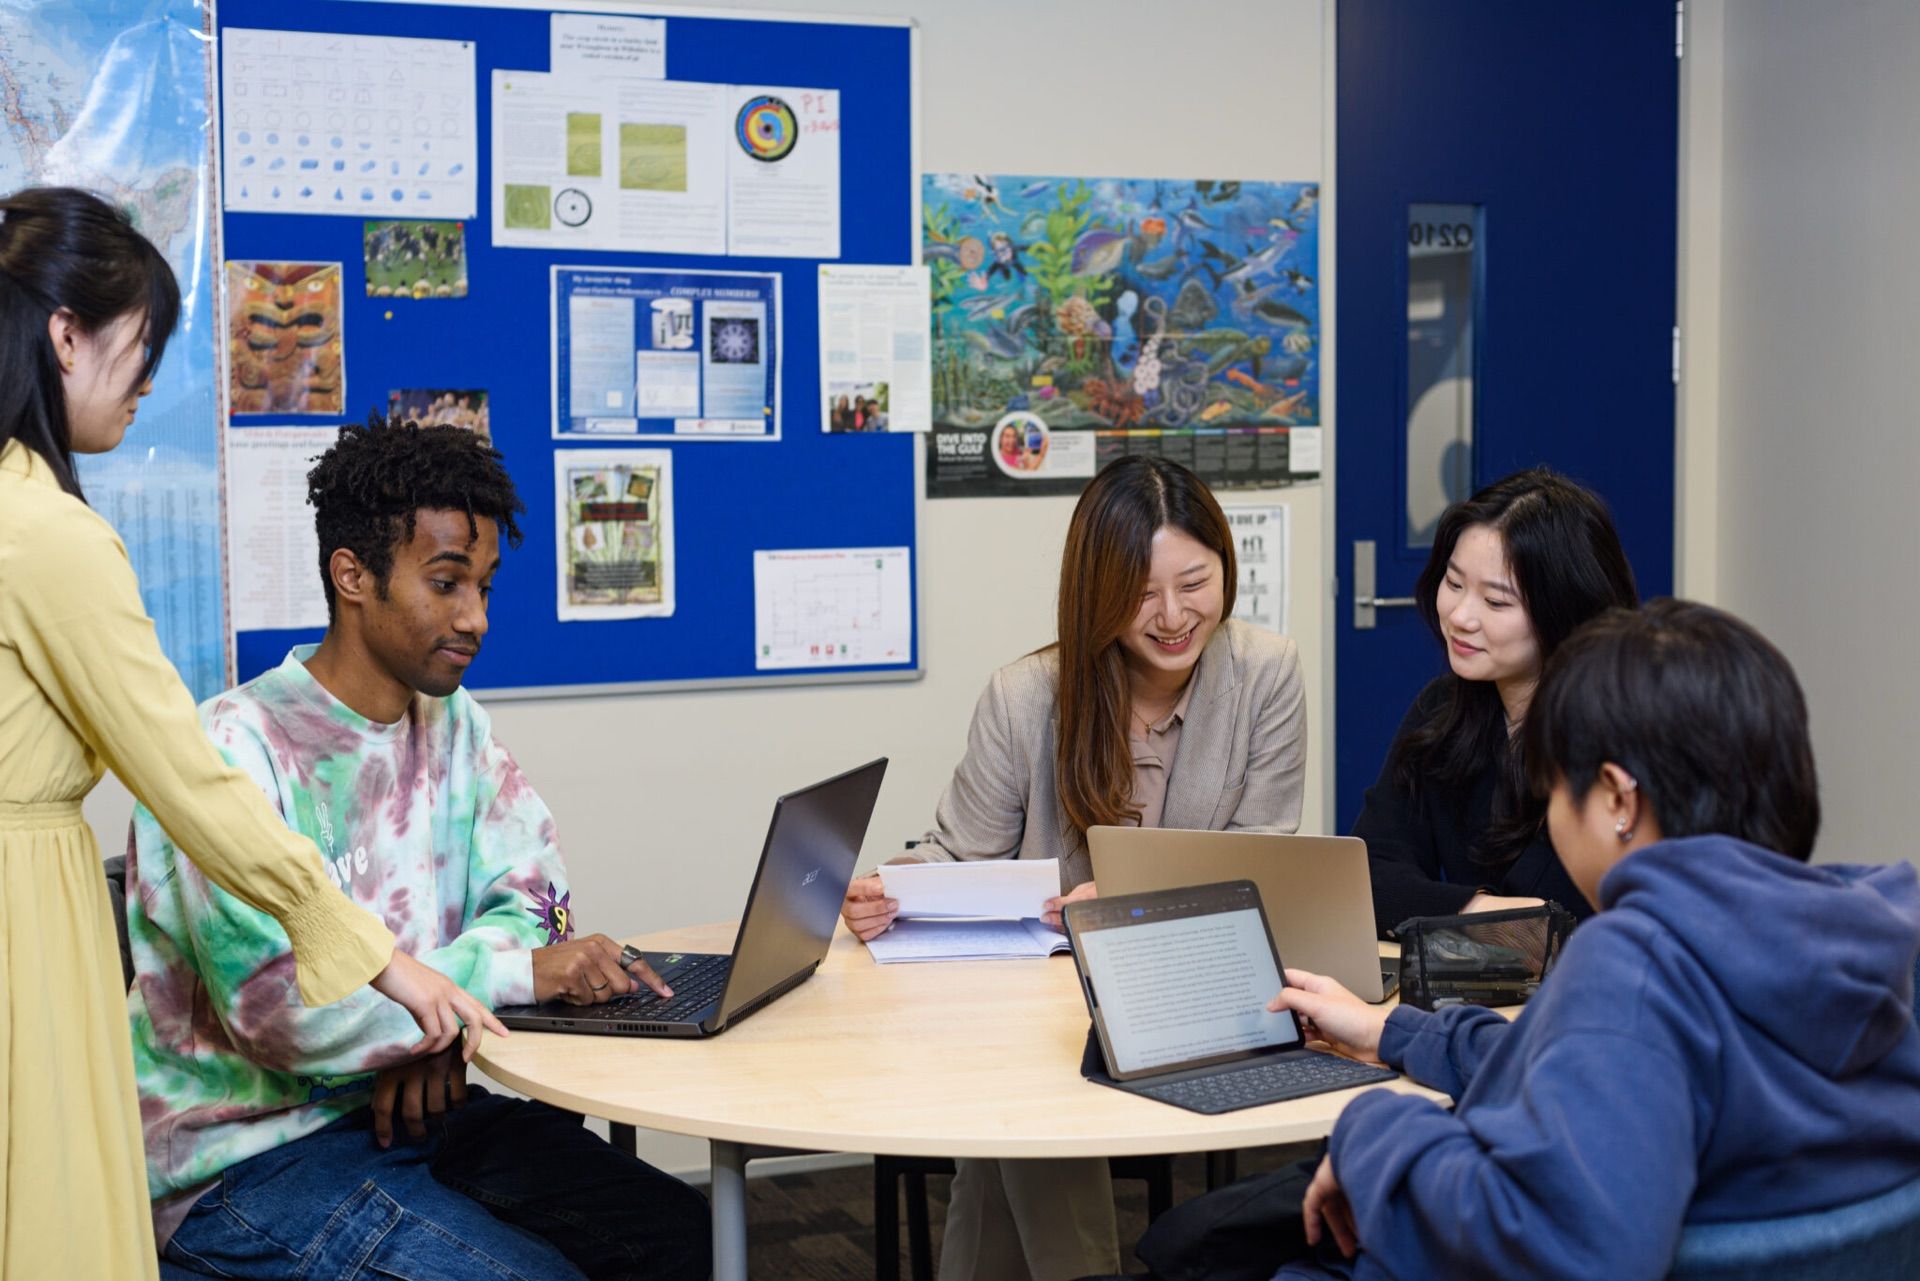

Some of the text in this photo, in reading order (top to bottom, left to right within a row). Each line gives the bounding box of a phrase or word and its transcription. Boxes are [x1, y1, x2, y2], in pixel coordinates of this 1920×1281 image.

[936, 432, 987, 444] DIVE INTO
[937, 444, 957, 455] THE
